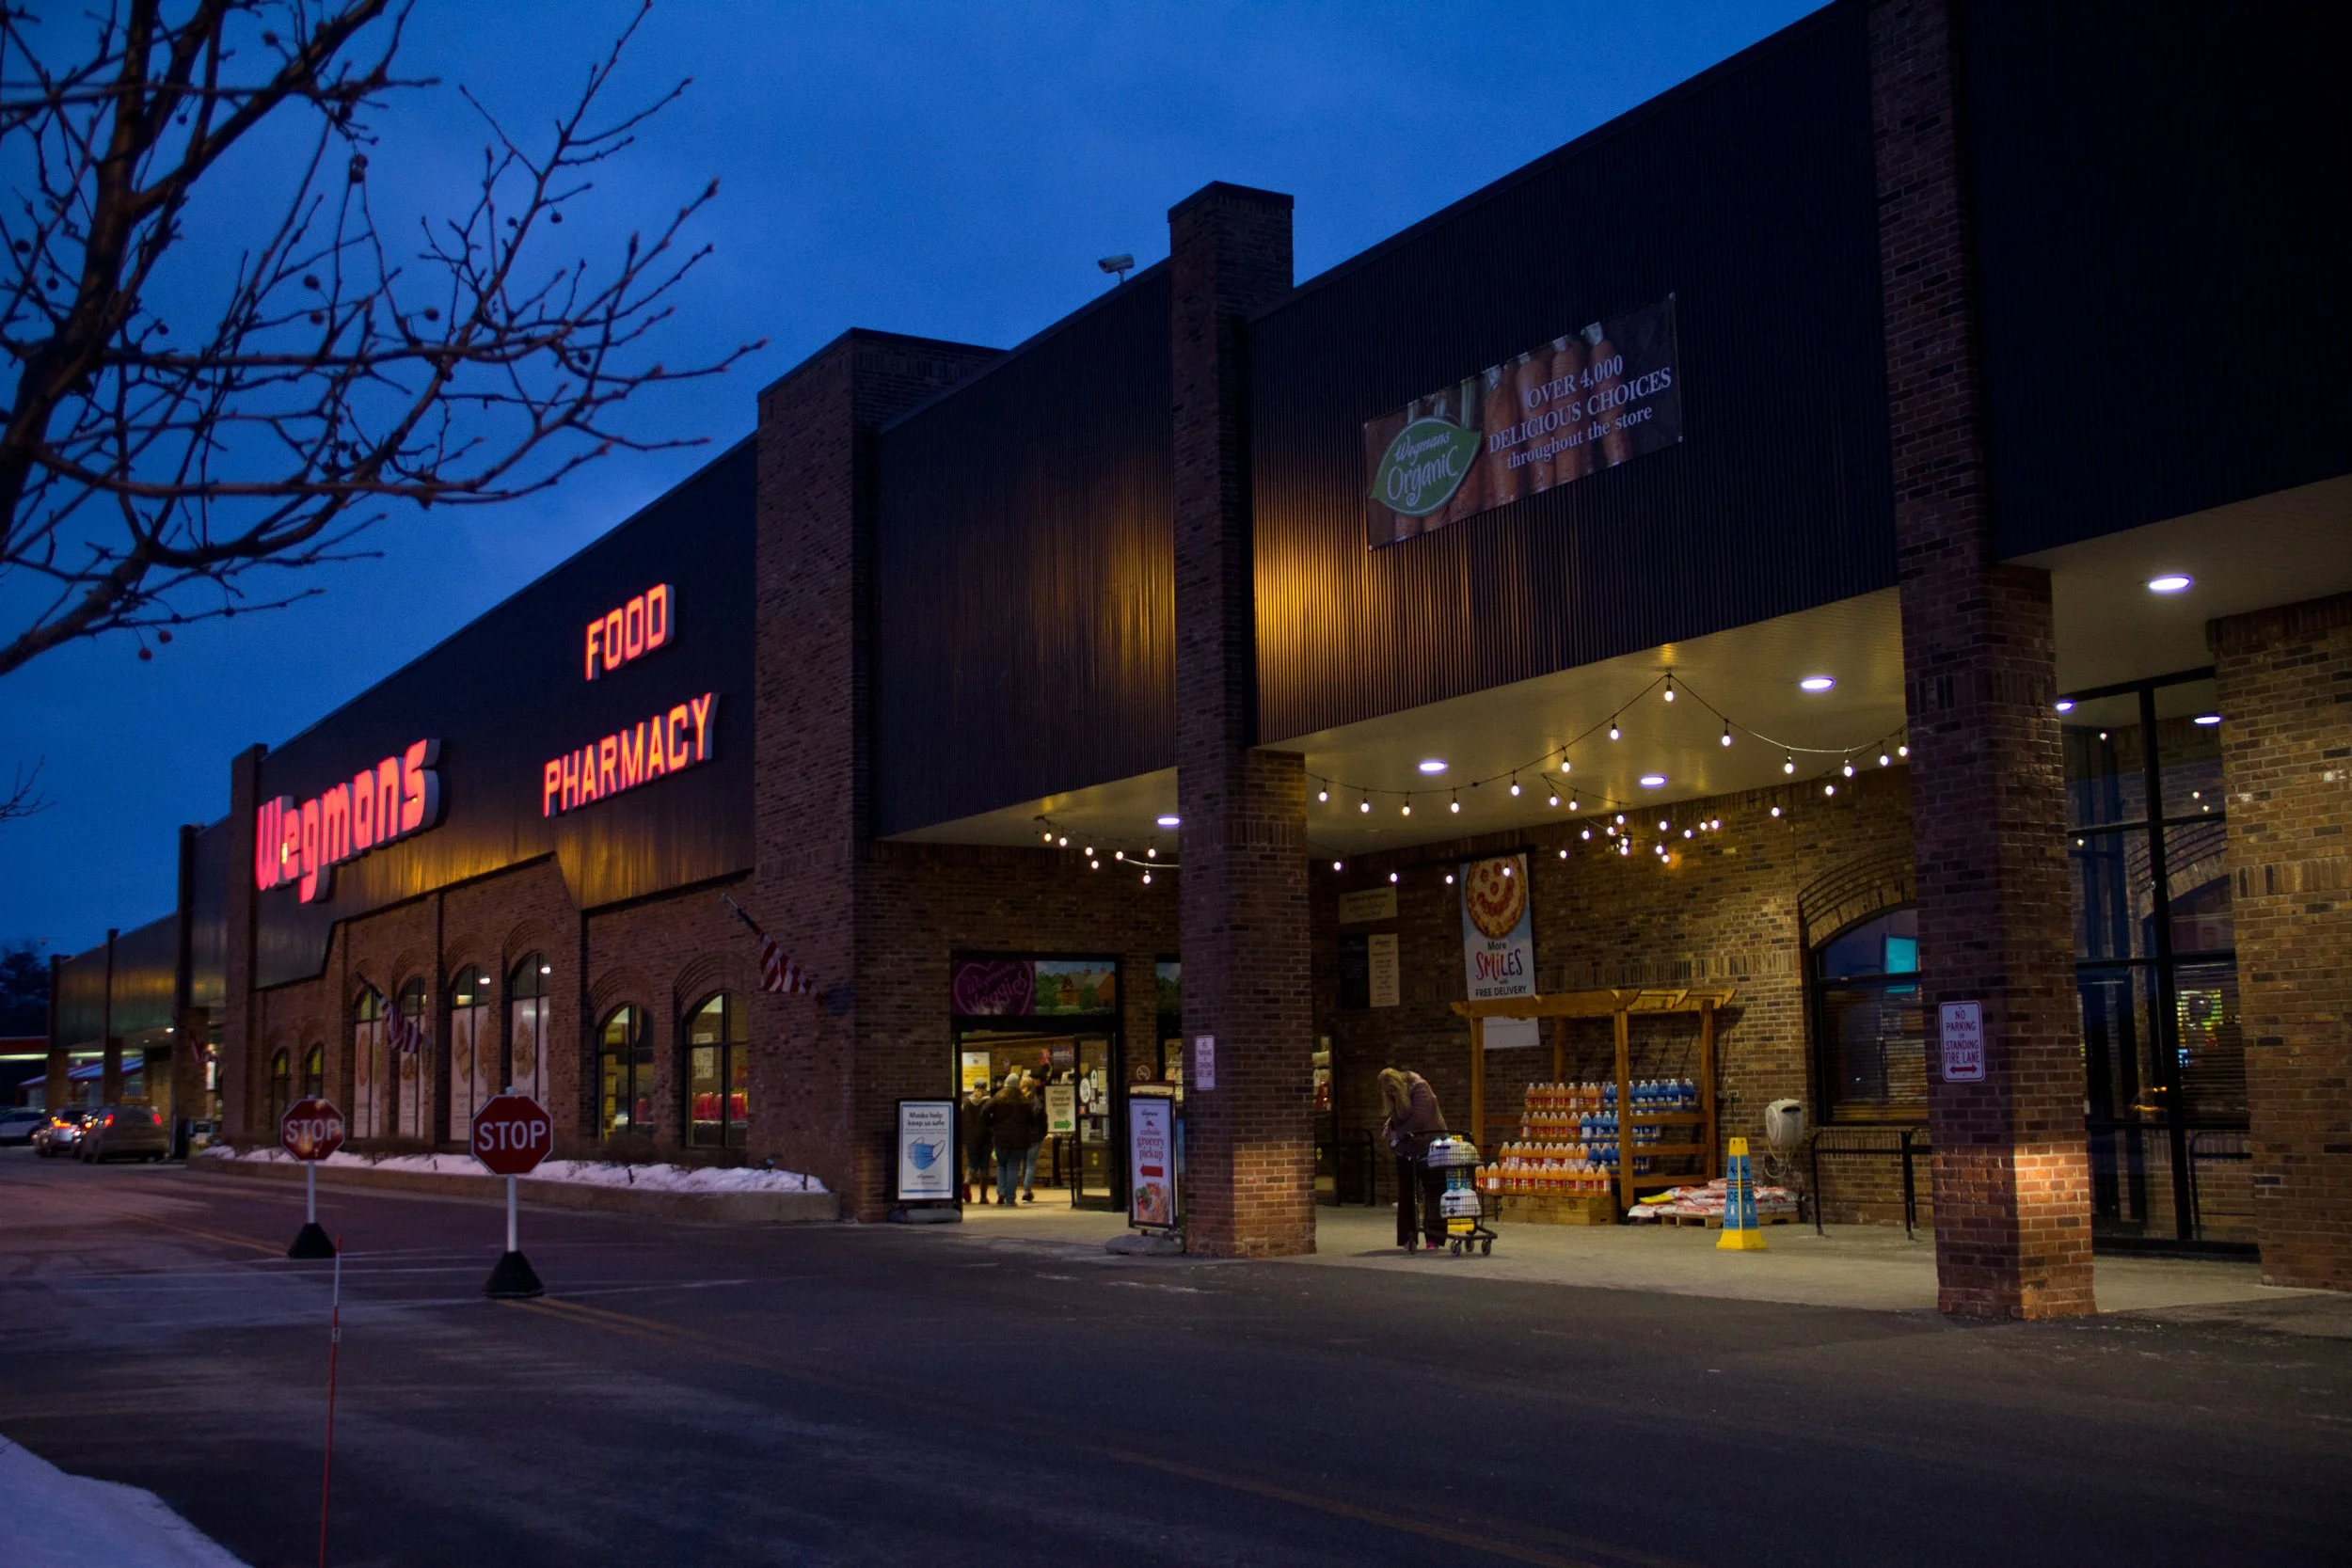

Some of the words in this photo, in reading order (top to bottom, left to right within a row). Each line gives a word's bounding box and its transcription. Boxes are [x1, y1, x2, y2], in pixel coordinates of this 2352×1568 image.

[1527, 373, 1576, 409] OVER
[1580, 353, 1624, 388] 4,000
[1488, 402, 1581, 454] DELICIOUS
[1587, 366, 1673, 417] CHOICES
[1393, 431, 1452, 467] Wegmans
[1507, 434, 1584, 470] throughout
[1587, 421, 1611, 442] the
[1614, 406, 1653, 432] store
[1387, 445, 1458, 508] Organic
[585, 583, 670, 680] FOOD
[543, 692, 715, 816] PHARMACY
[256, 738, 435, 903] Wegmans
[1487, 942, 1507, 951] More
[1475, 988, 1492, 997] FREE
[1494, 985, 1527, 995] DELIVERY
[1946, 1021, 1976, 1031] PARKING
[1955, 1010, 1965, 1020] NO
[1946, 1039, 1979, 1051] STANDING
[1946, 1053, 1960, 1064] FIRE
[1963, 1052, 1979, 1063] LANE
[286, 1118, 341, 1145] STOP
[478, 1120, 548, 1151] STOP
[1136, 1136, 1164, 1148] grocery
[1139, 1148, 1164, 1162] pickup
[1726, 1191, 1739, 1202] ICE
